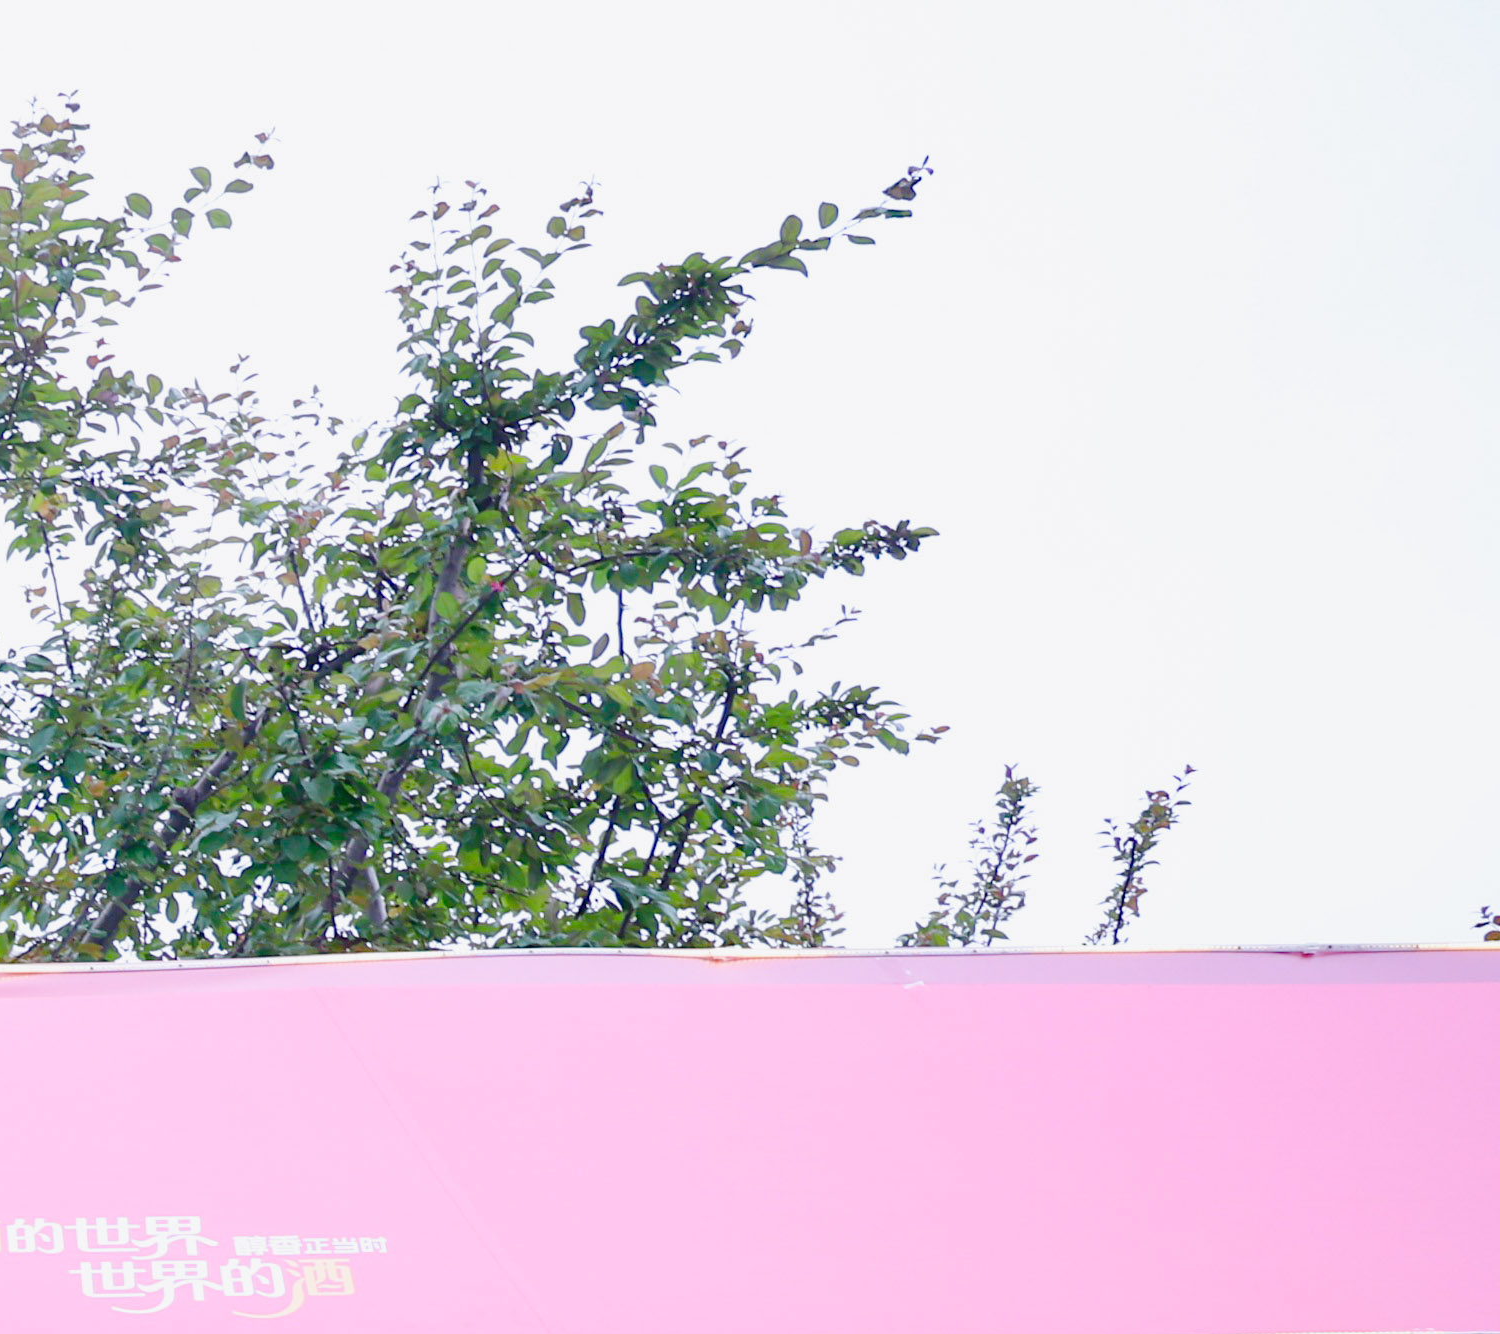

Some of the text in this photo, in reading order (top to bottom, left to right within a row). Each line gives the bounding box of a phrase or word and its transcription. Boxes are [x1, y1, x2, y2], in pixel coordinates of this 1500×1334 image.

[233, 1235, 388, 1256] 醇香正当时
[68, 1257, 356, 1319] 世界的酒
